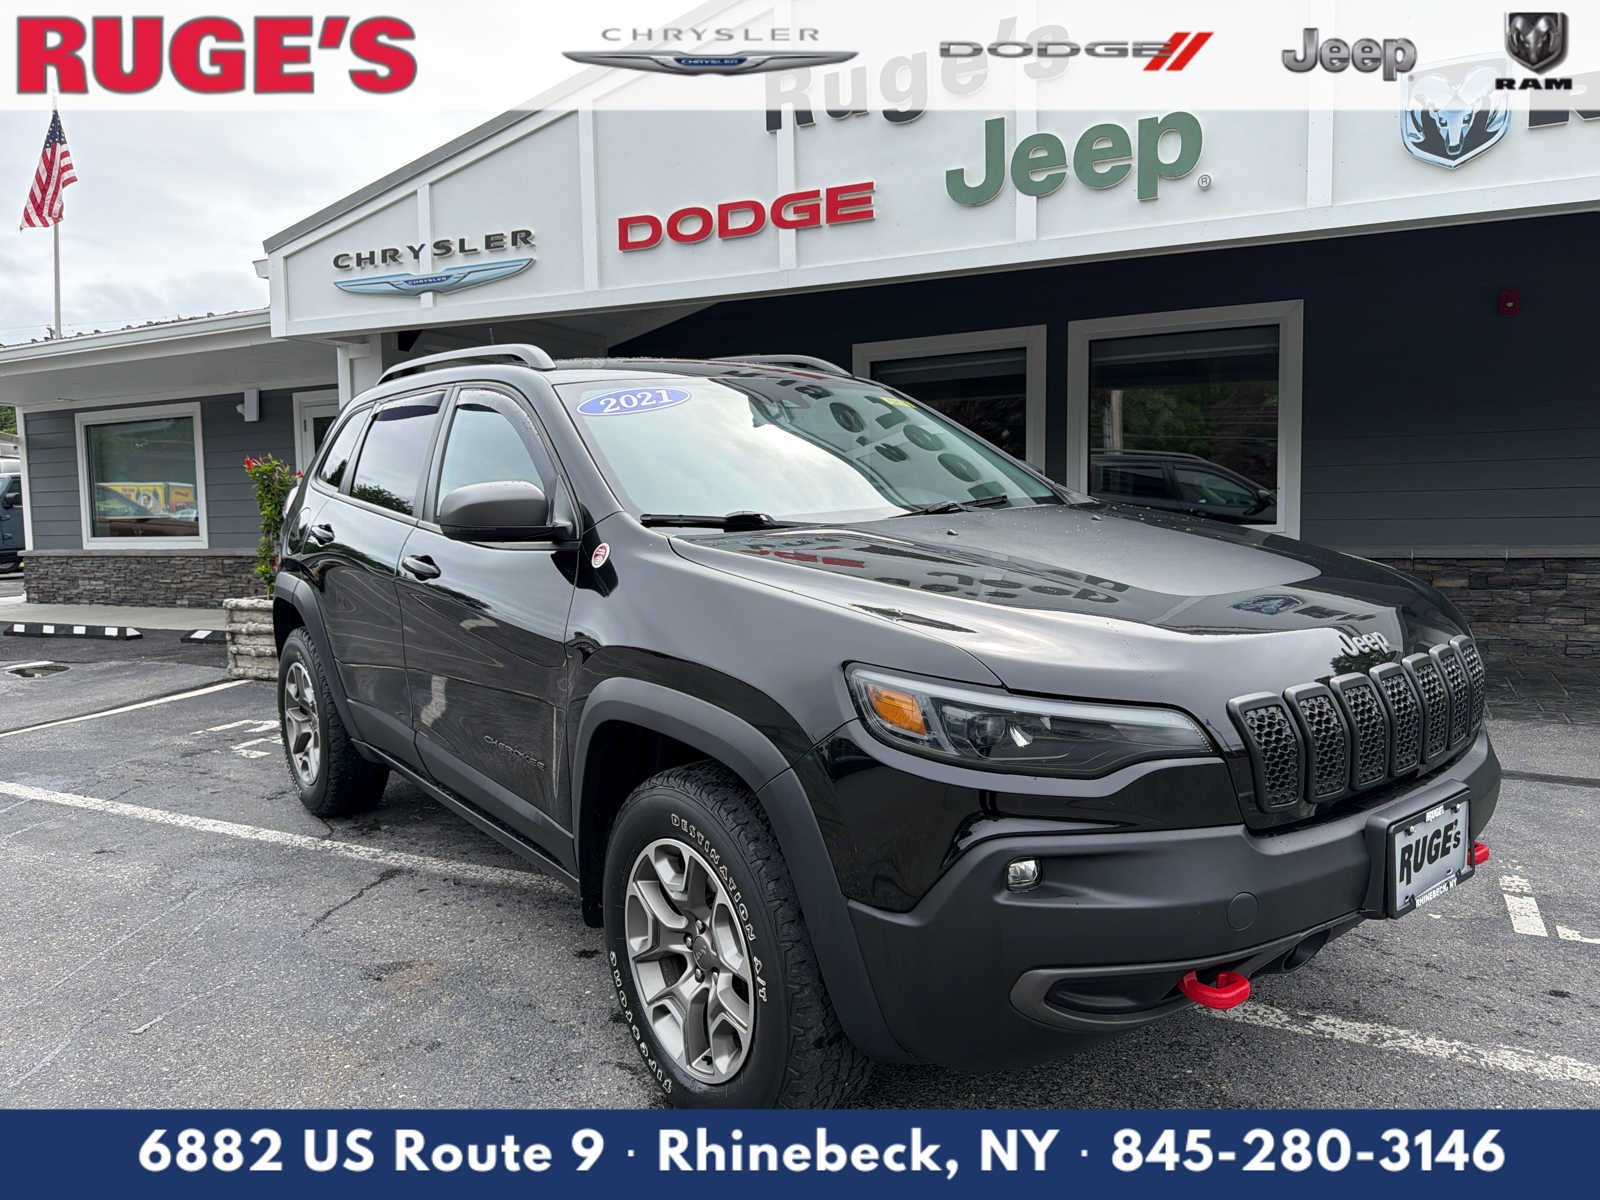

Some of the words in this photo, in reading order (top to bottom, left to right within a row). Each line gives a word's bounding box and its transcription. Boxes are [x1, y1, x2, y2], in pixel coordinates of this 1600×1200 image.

[945, 110, 1204, 207] Jeep
[617, 181, 876, 252] DODGE
[333, 229, 535, 270] CHRYSLER
[600, 388, 674, 413] 2021
[1338, 631, 1391, 657] Jeep
[671, 813, 755, 942] DESTINATION
[753, 955, 768, 1003] A/T
